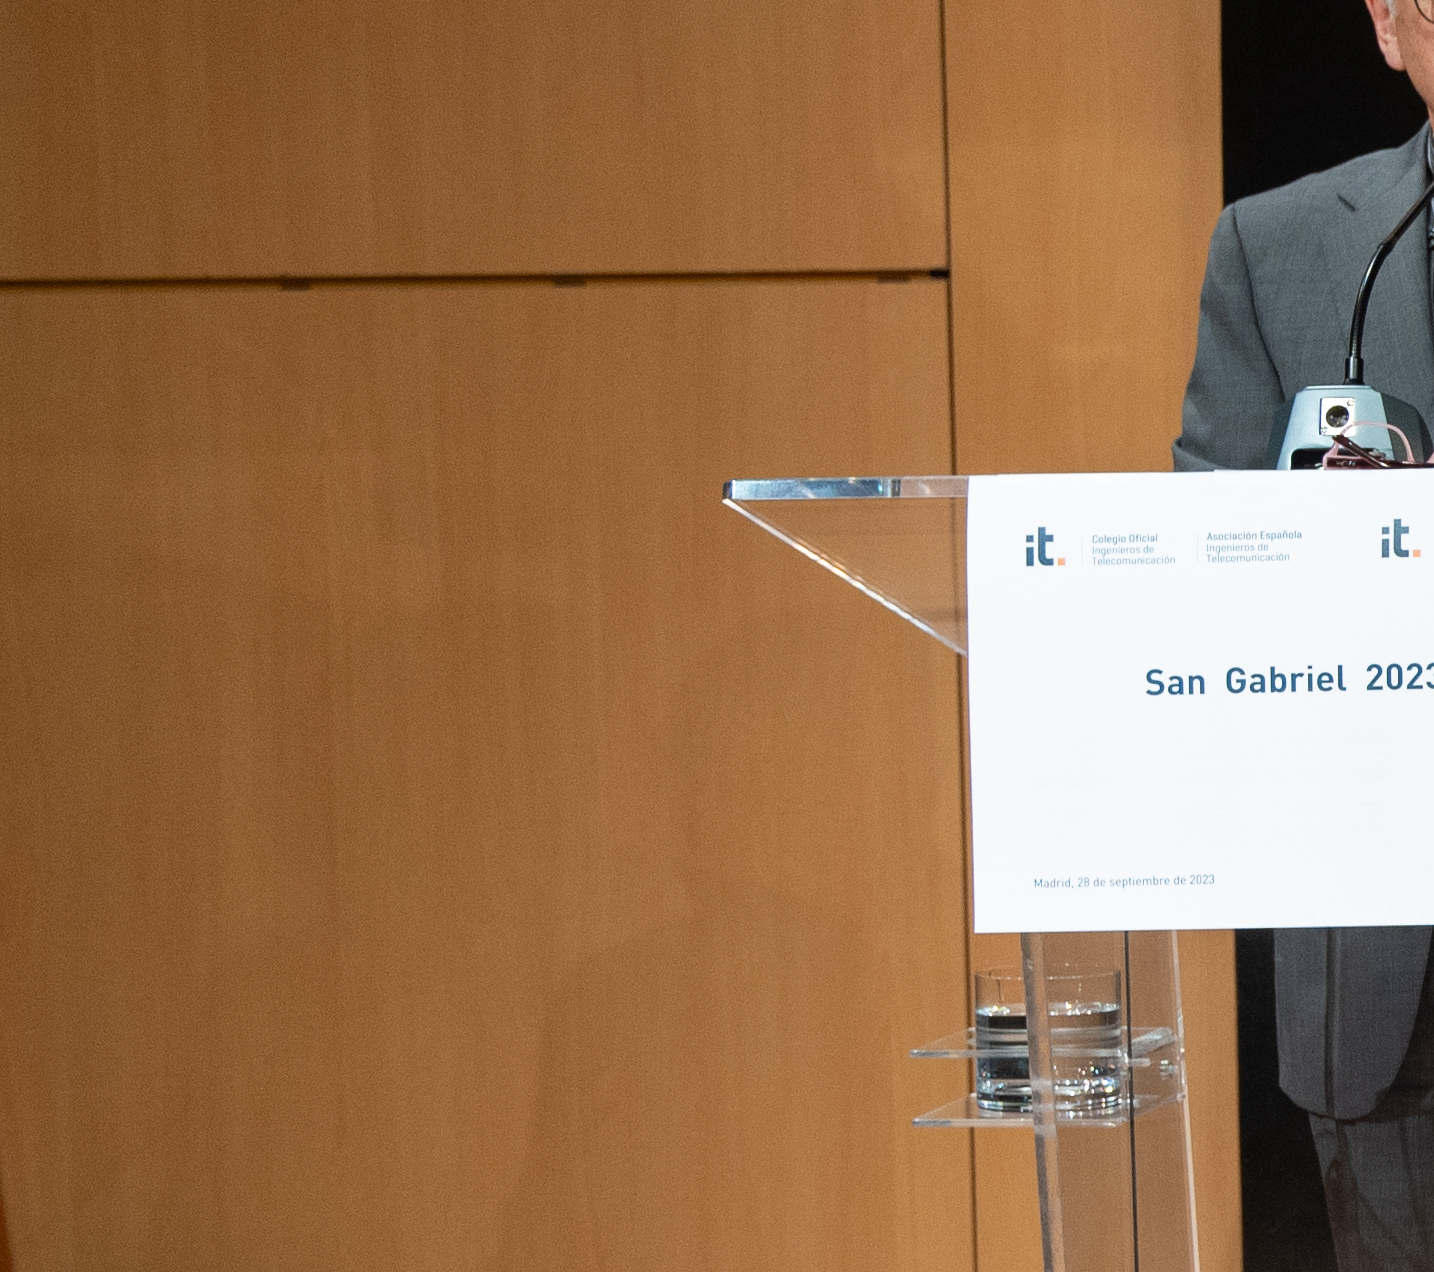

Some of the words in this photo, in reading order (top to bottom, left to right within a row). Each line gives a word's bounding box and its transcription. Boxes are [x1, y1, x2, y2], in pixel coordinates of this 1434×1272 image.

[1092, 534, 1126, 546] Colegio
[1128, 533, 1158, 543] Oficial
[1206, 532, 1258, 540] Asociación
[1260, 530, 1302, 541] Española
[1092, 546, 1142, 556] Ingenieros
[1144, 545, 1154, 554] de
[1206, 544, 1256, 554] Ingenieros
[1258, 542, 1268, 551] de
[1092, 556, 1176, 566] Telecomunicación
[1206, 553, 1290, 562] Telecomunicación
[1145, 668, 1206, 696] San
[1225, 665, 1347, 694] Gabriel
[1034, 878, 1074, 888] Madrid,
[1078, 877, 1089, 887] 28
[1093, 877, 1106, 887] de
[1109, 876, 1170, 888] septiembre
[1173, 875, 1186, 885] de
[1190, 875, 1215, 885] 2023
